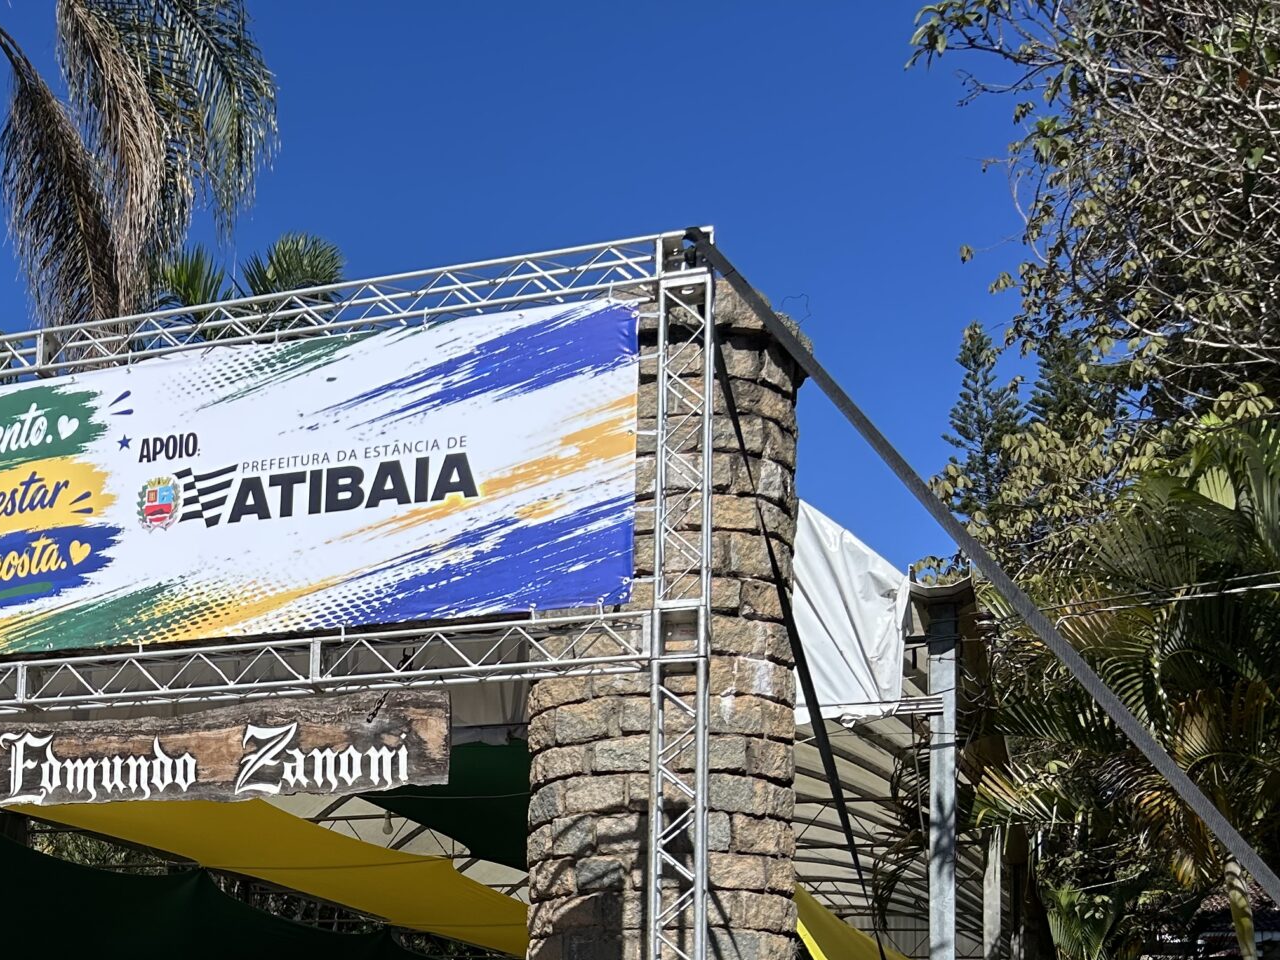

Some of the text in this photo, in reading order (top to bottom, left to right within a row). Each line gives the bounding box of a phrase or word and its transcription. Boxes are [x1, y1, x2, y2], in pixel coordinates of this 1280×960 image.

[138, 432, 201, 463] APOIO:
[242, 435, 468, 473] PREFEITURA DA ESTÂNCIA DE
[227, 452, 479, 524] ATIBAIA
[235, 722, 409, 796] Zanoni
